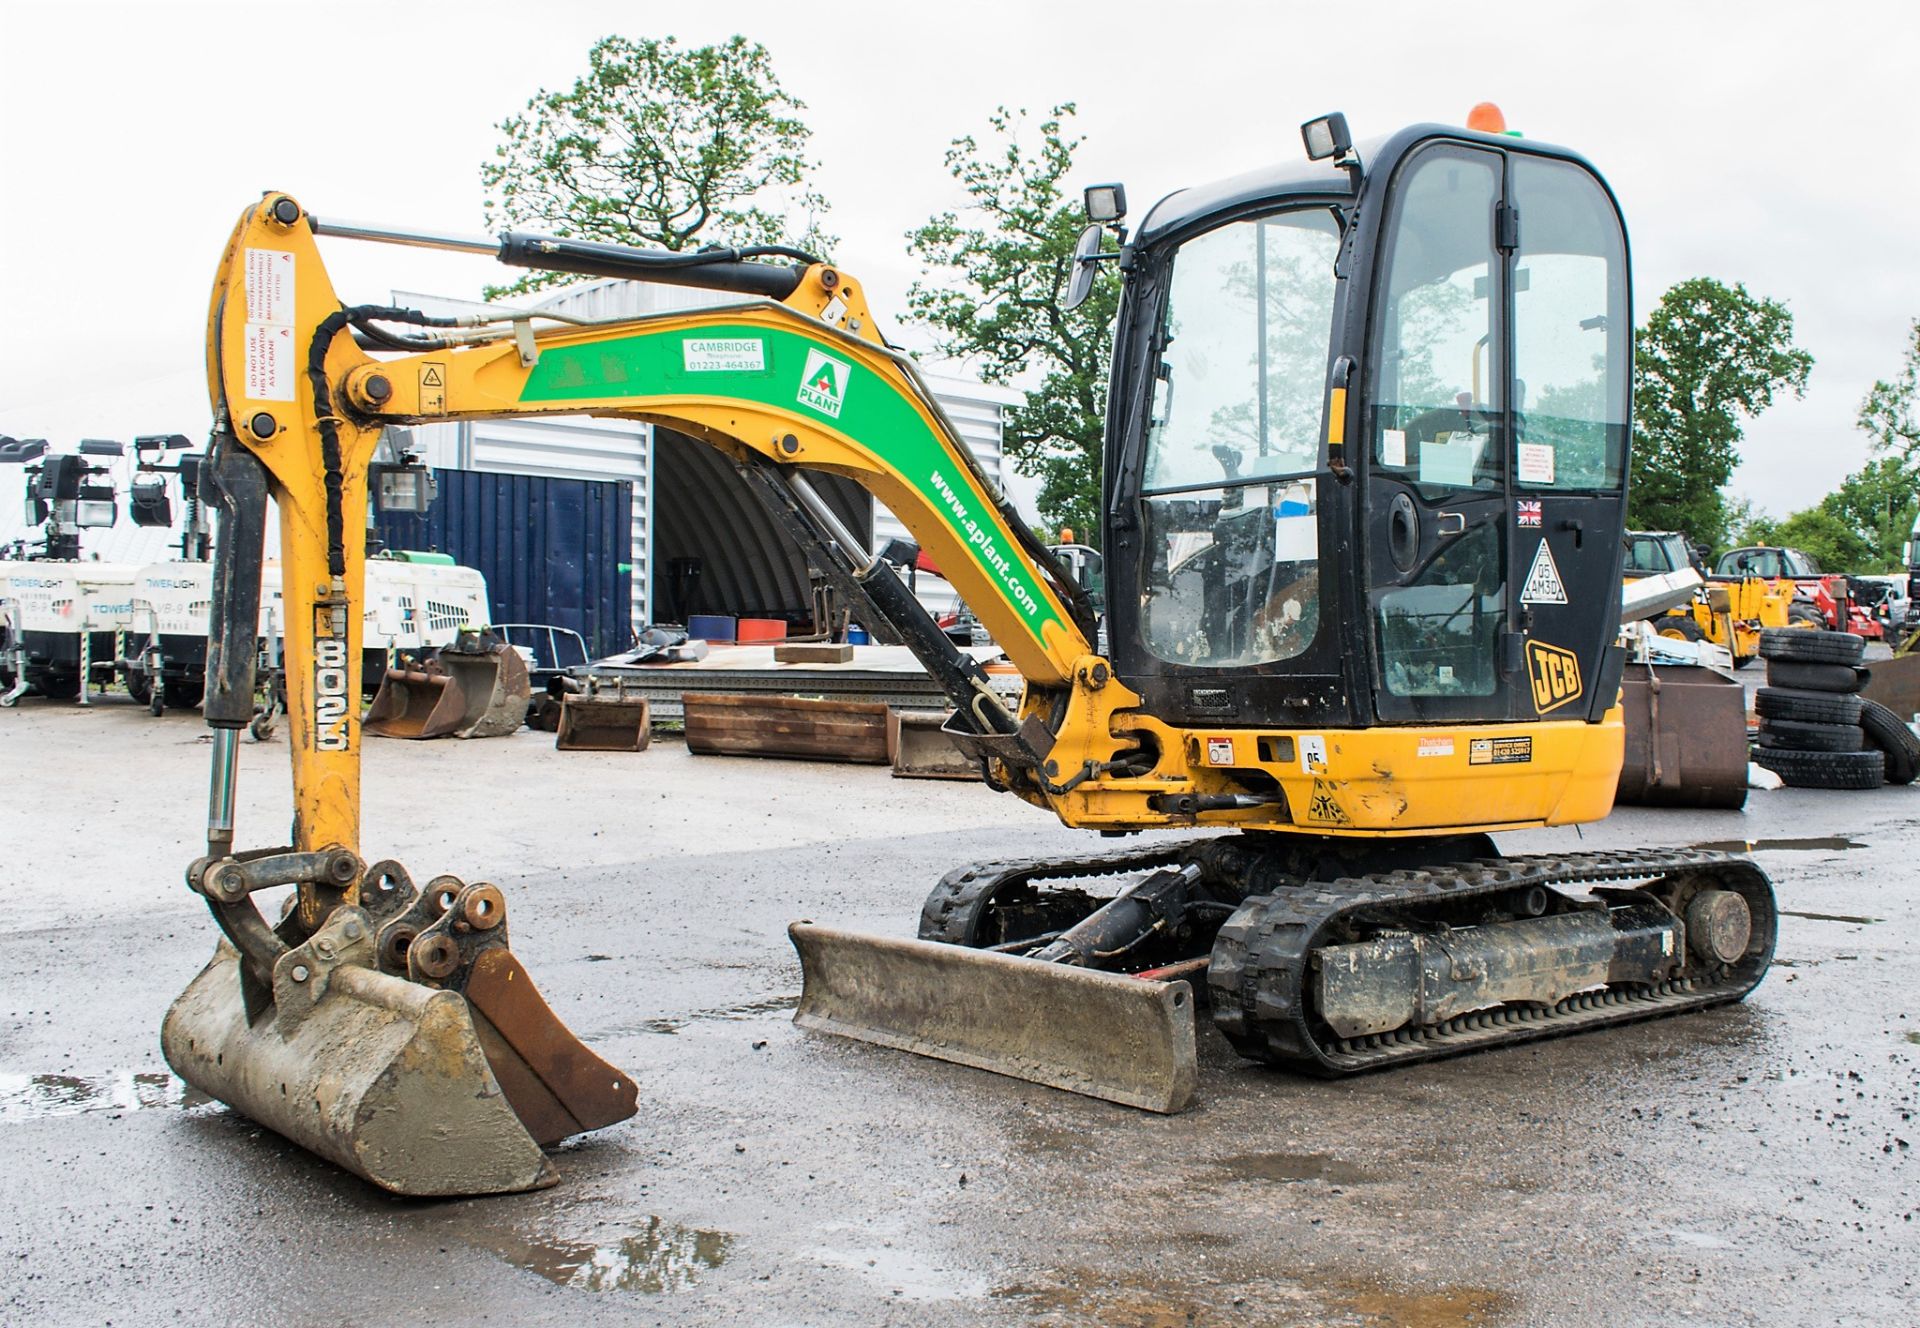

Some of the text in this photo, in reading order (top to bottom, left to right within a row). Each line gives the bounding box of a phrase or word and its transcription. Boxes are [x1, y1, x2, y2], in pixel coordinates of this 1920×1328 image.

[690, 342, 757, 352] CAMBRIDGE
[690, 361, 720, 370] 01223
[250, 374, 257, 387] DO
[269, 376, 275, 387] AS
[806, 361, 839, 398] A
[800, 388, 840, 413] PLANT
[929, 470, 1038, 616] www.aplant.com
[10, 577, 63, 588] TOWERLIGHT
[1531, 579, 1557, 595] AM3D
[1534, 649, 1578, 705] JCB
[316, 640, 347, 751] 8025
